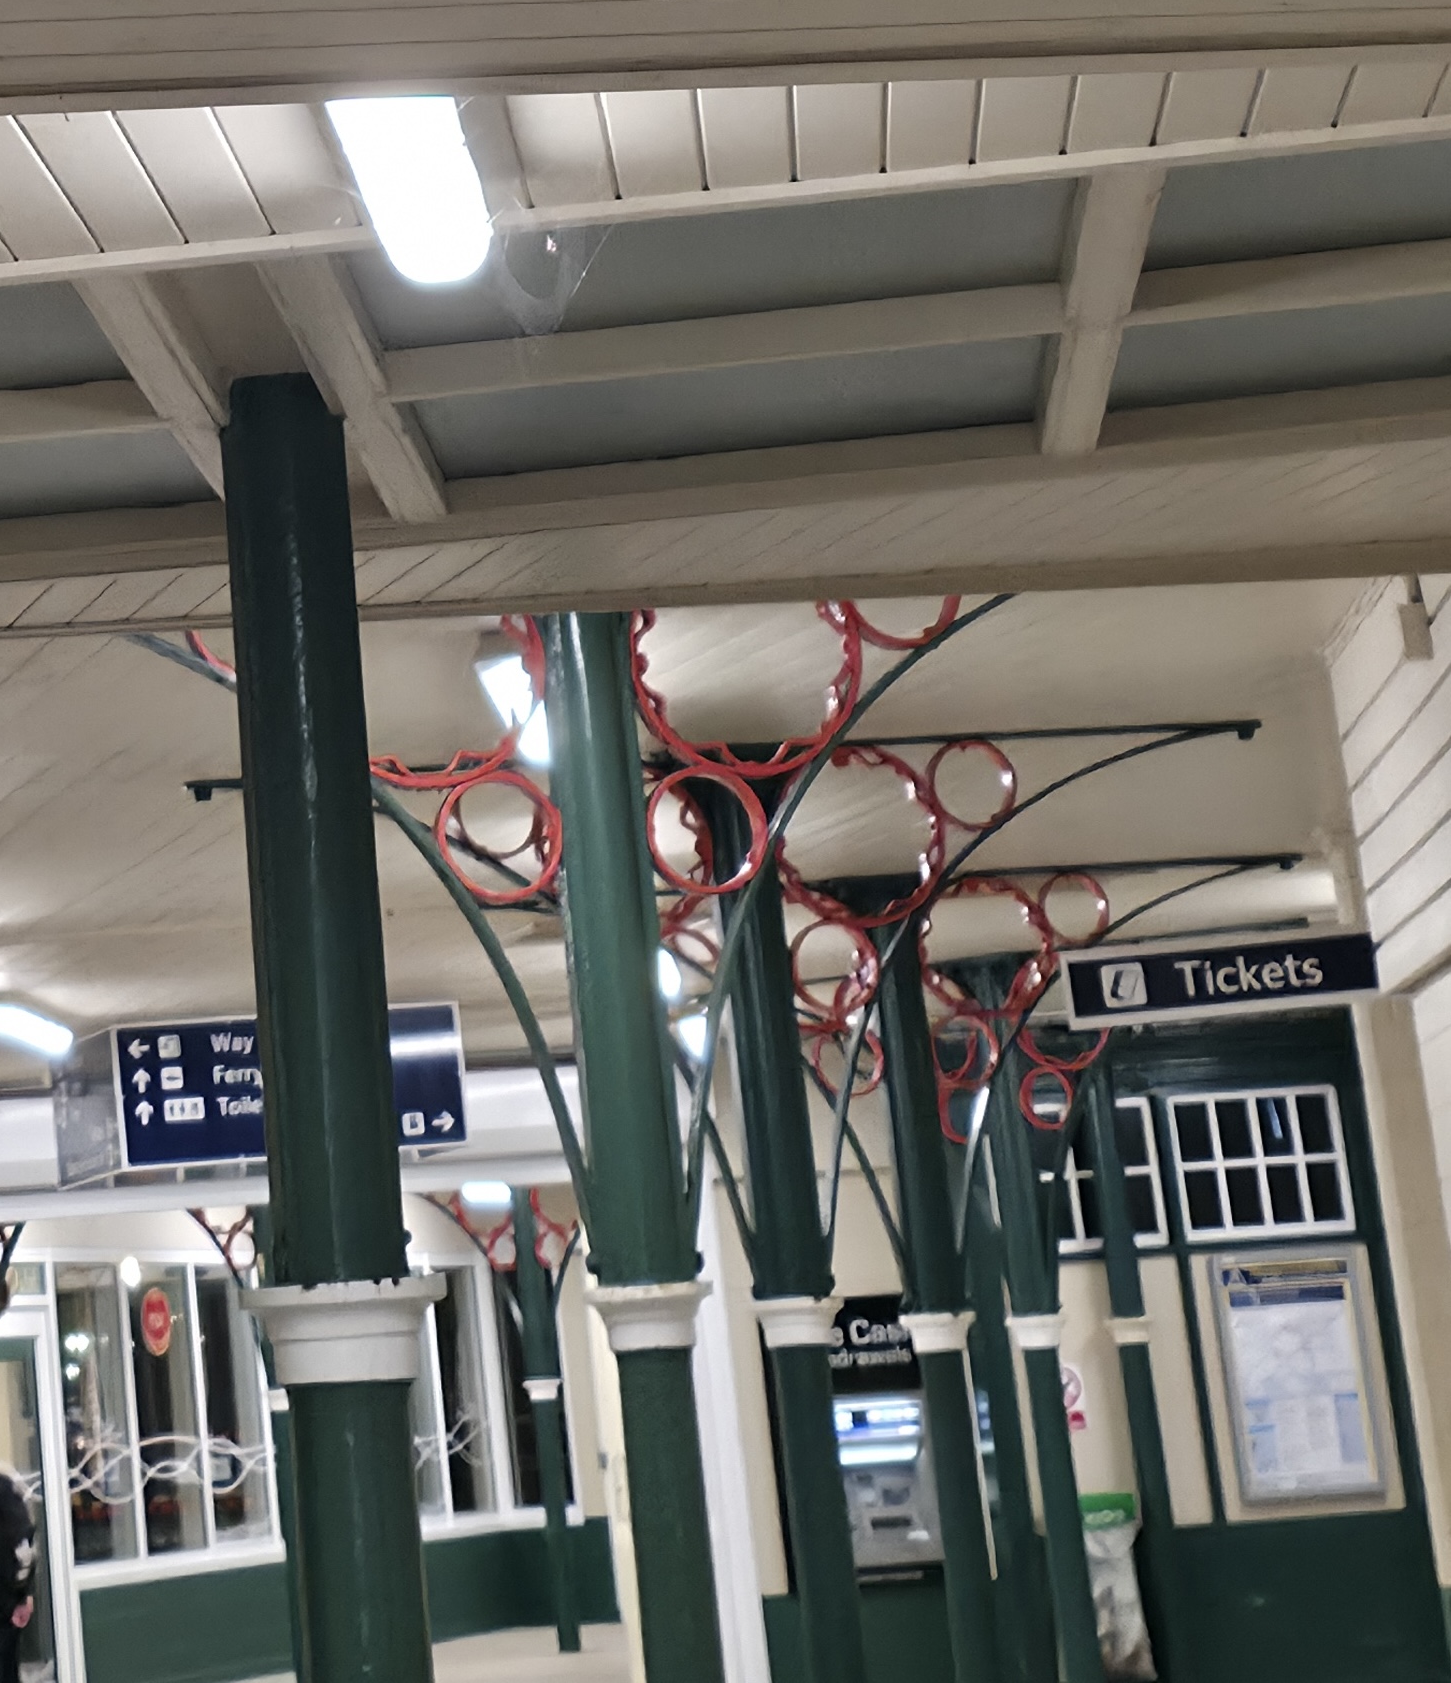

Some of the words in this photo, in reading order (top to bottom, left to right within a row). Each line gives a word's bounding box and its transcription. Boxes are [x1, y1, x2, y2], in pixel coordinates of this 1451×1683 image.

[1174, 953, 1323, 999] Tickets
[210, 1032, 254, 1054] Way
[216, 1095, 264, 1116] Toile
